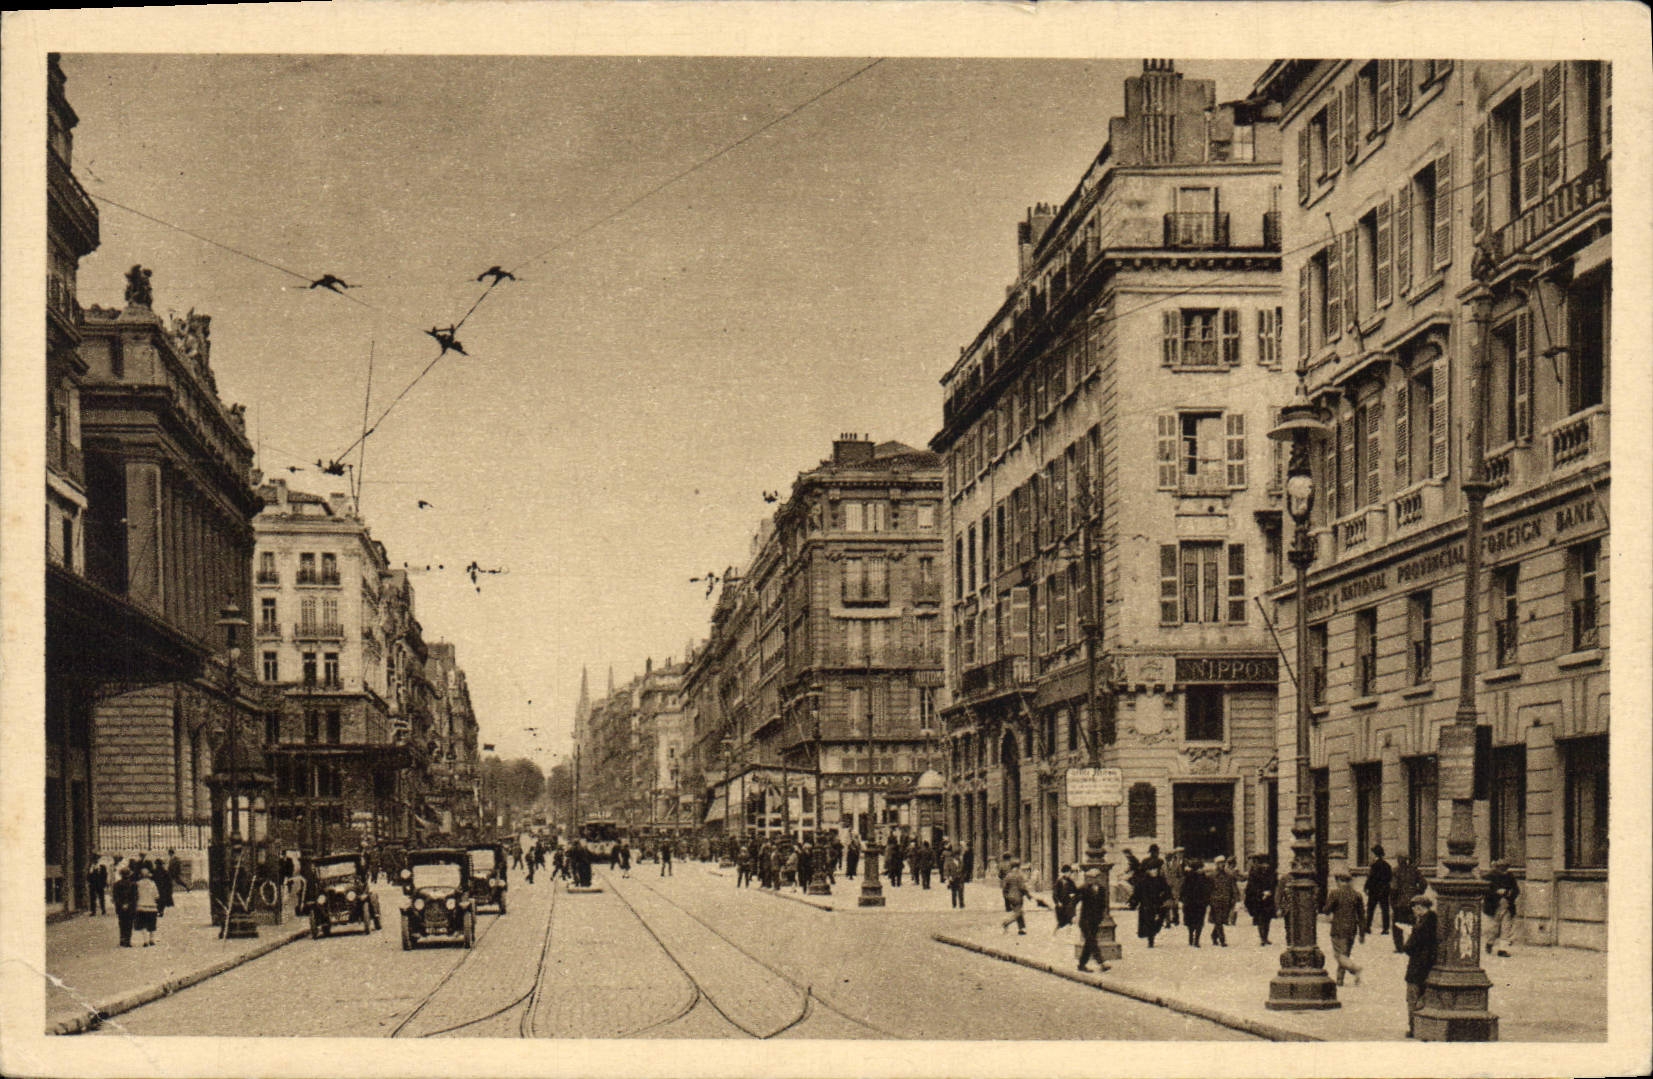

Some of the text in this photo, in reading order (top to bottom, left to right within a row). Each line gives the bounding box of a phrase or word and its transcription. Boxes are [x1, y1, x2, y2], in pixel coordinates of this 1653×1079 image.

[1340, 572, 1386, 602] NATIONAL
[1397, 543, 1465, 583] PROVINCIAL
[1480, 518, 1542, 556] FOREIGN
[1555, 500, 1595, 533] BANK
[1186, 660, 1275, 680] NIPPON
